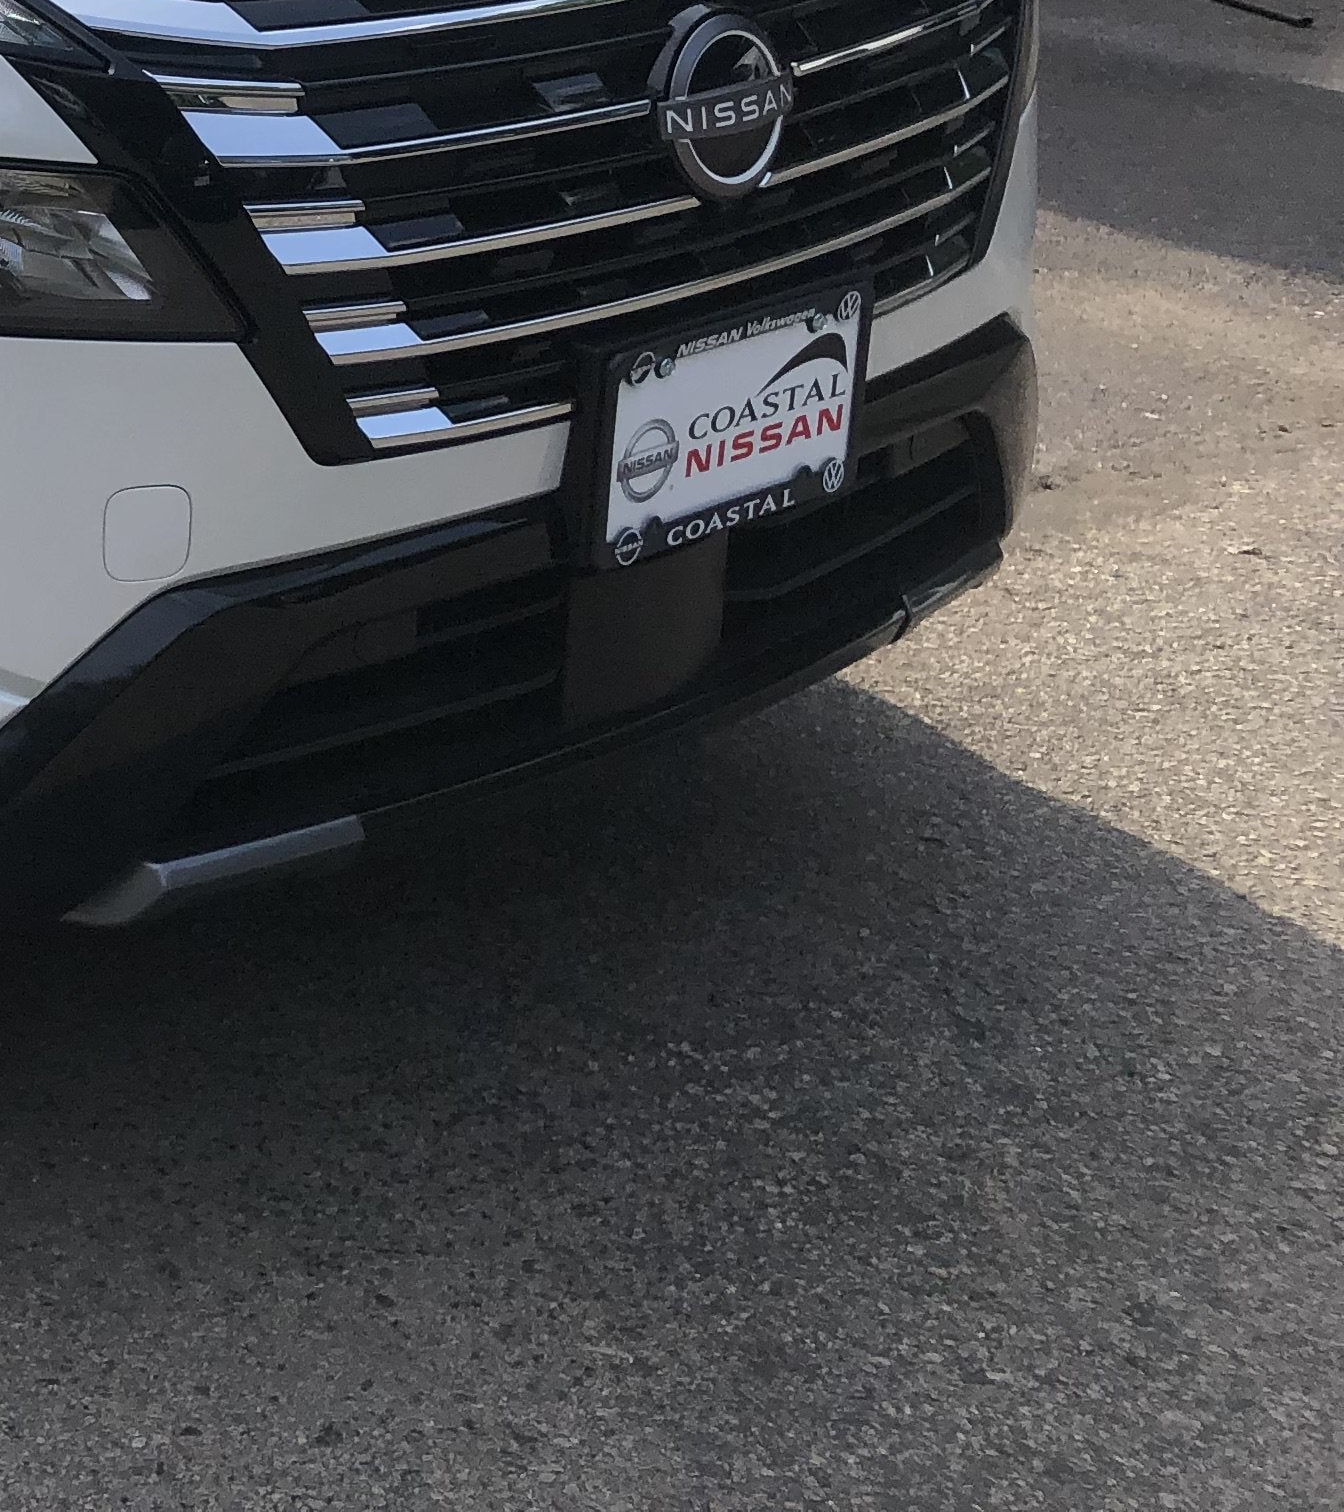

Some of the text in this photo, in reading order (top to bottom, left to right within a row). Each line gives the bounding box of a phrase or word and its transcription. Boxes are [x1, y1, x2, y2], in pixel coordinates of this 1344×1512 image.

[665, 83, 793, 134] NISSAN
[676, 326, 744, 358] NISSAN
[688, 372, 847, 440] COASTAL
[622, 447, 675, 475] NISSAN
[684, 404, 844, 477] NISSAN
[666, 487, 796, 547] COASTAL
